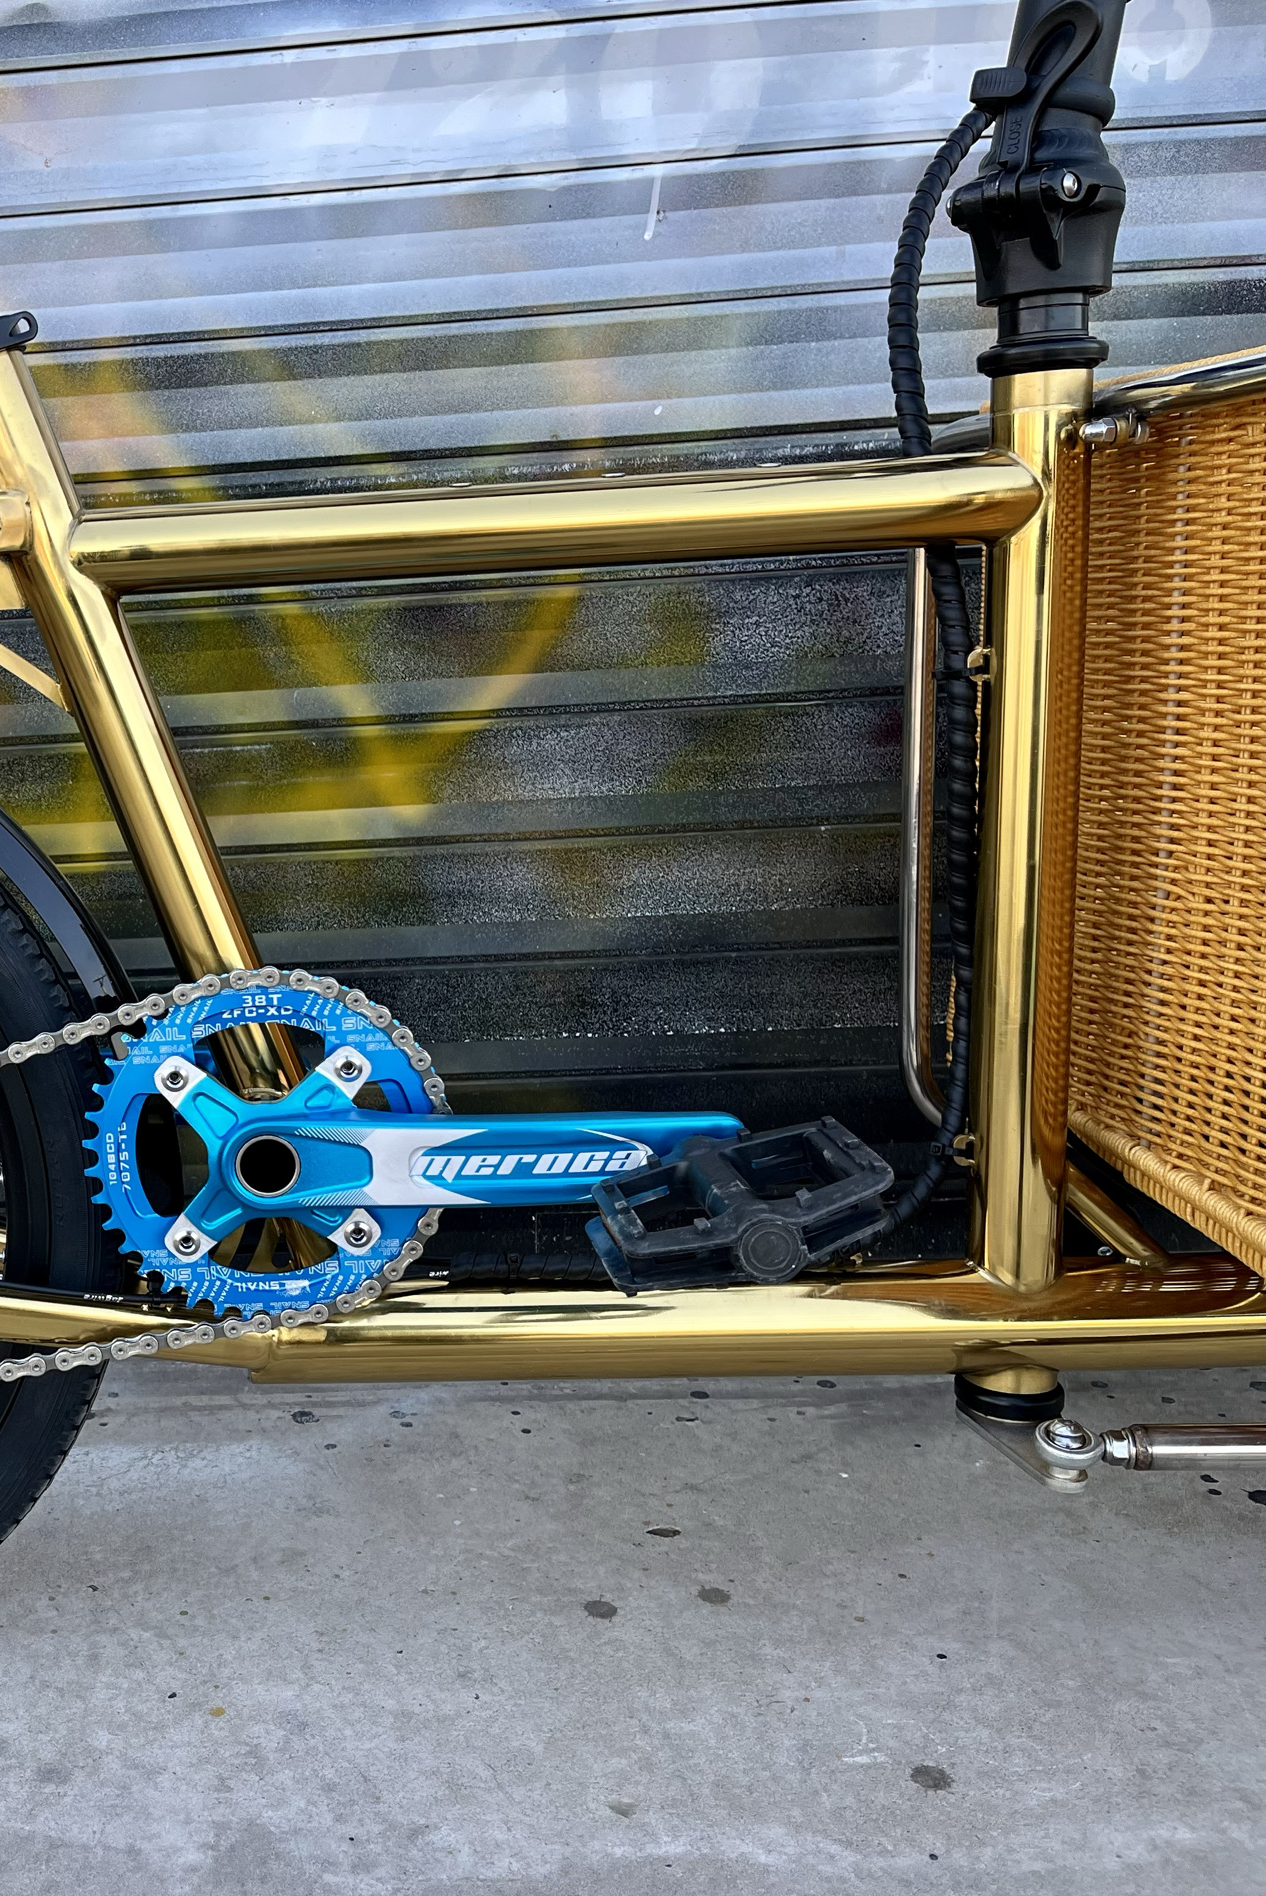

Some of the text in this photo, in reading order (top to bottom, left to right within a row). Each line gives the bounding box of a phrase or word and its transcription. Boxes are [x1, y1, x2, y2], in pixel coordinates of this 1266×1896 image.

[1006, 116, 1024, 155] CLOSE
[222, 1006, 294, 1019] ZFC-XD
[242, 994, 283, 1007] 38T
[105, 1132, 118, 1186] 104BCD
[117, 1122, 132, 1193] 7075-T6
[233, 1280, 281, 1293] SNAIL
